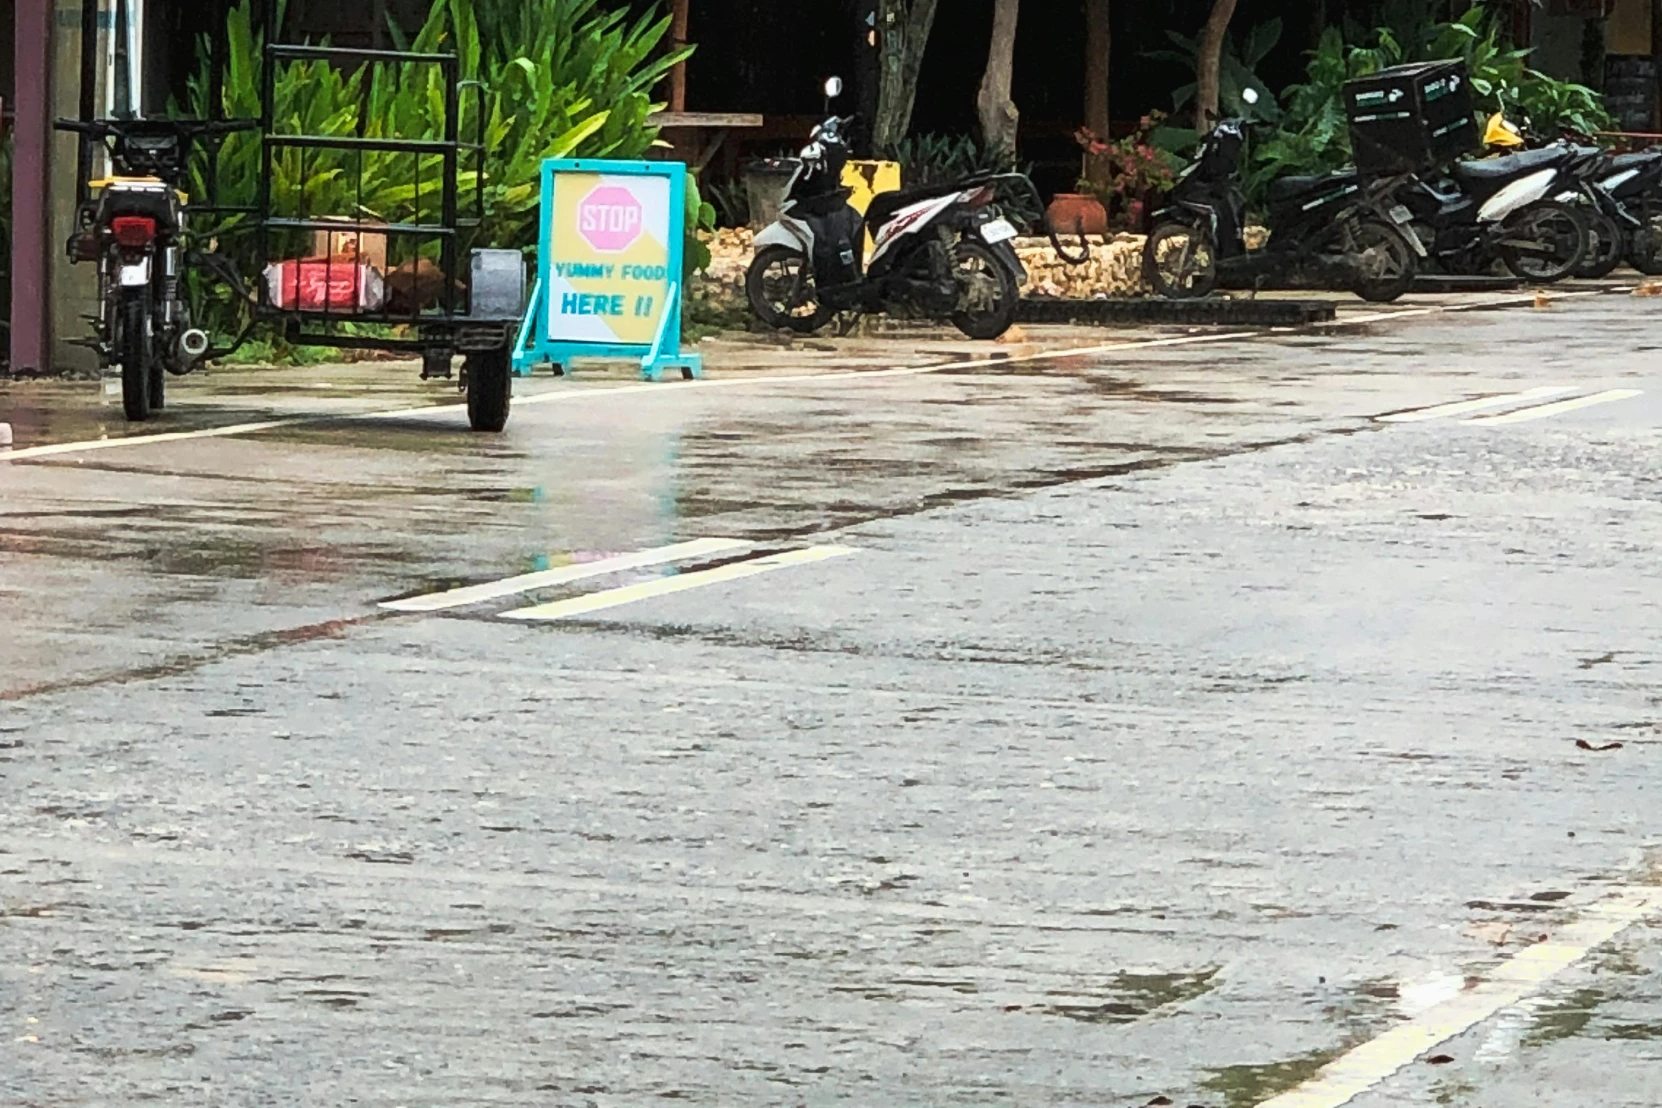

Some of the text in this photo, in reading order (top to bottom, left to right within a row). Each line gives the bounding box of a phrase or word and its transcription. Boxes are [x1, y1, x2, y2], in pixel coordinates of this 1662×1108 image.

[582, 204, 638, 233] STOP
[556, 262, 666, 281] YUMMY FOOD
[561, 292, 625, 316] HERE
